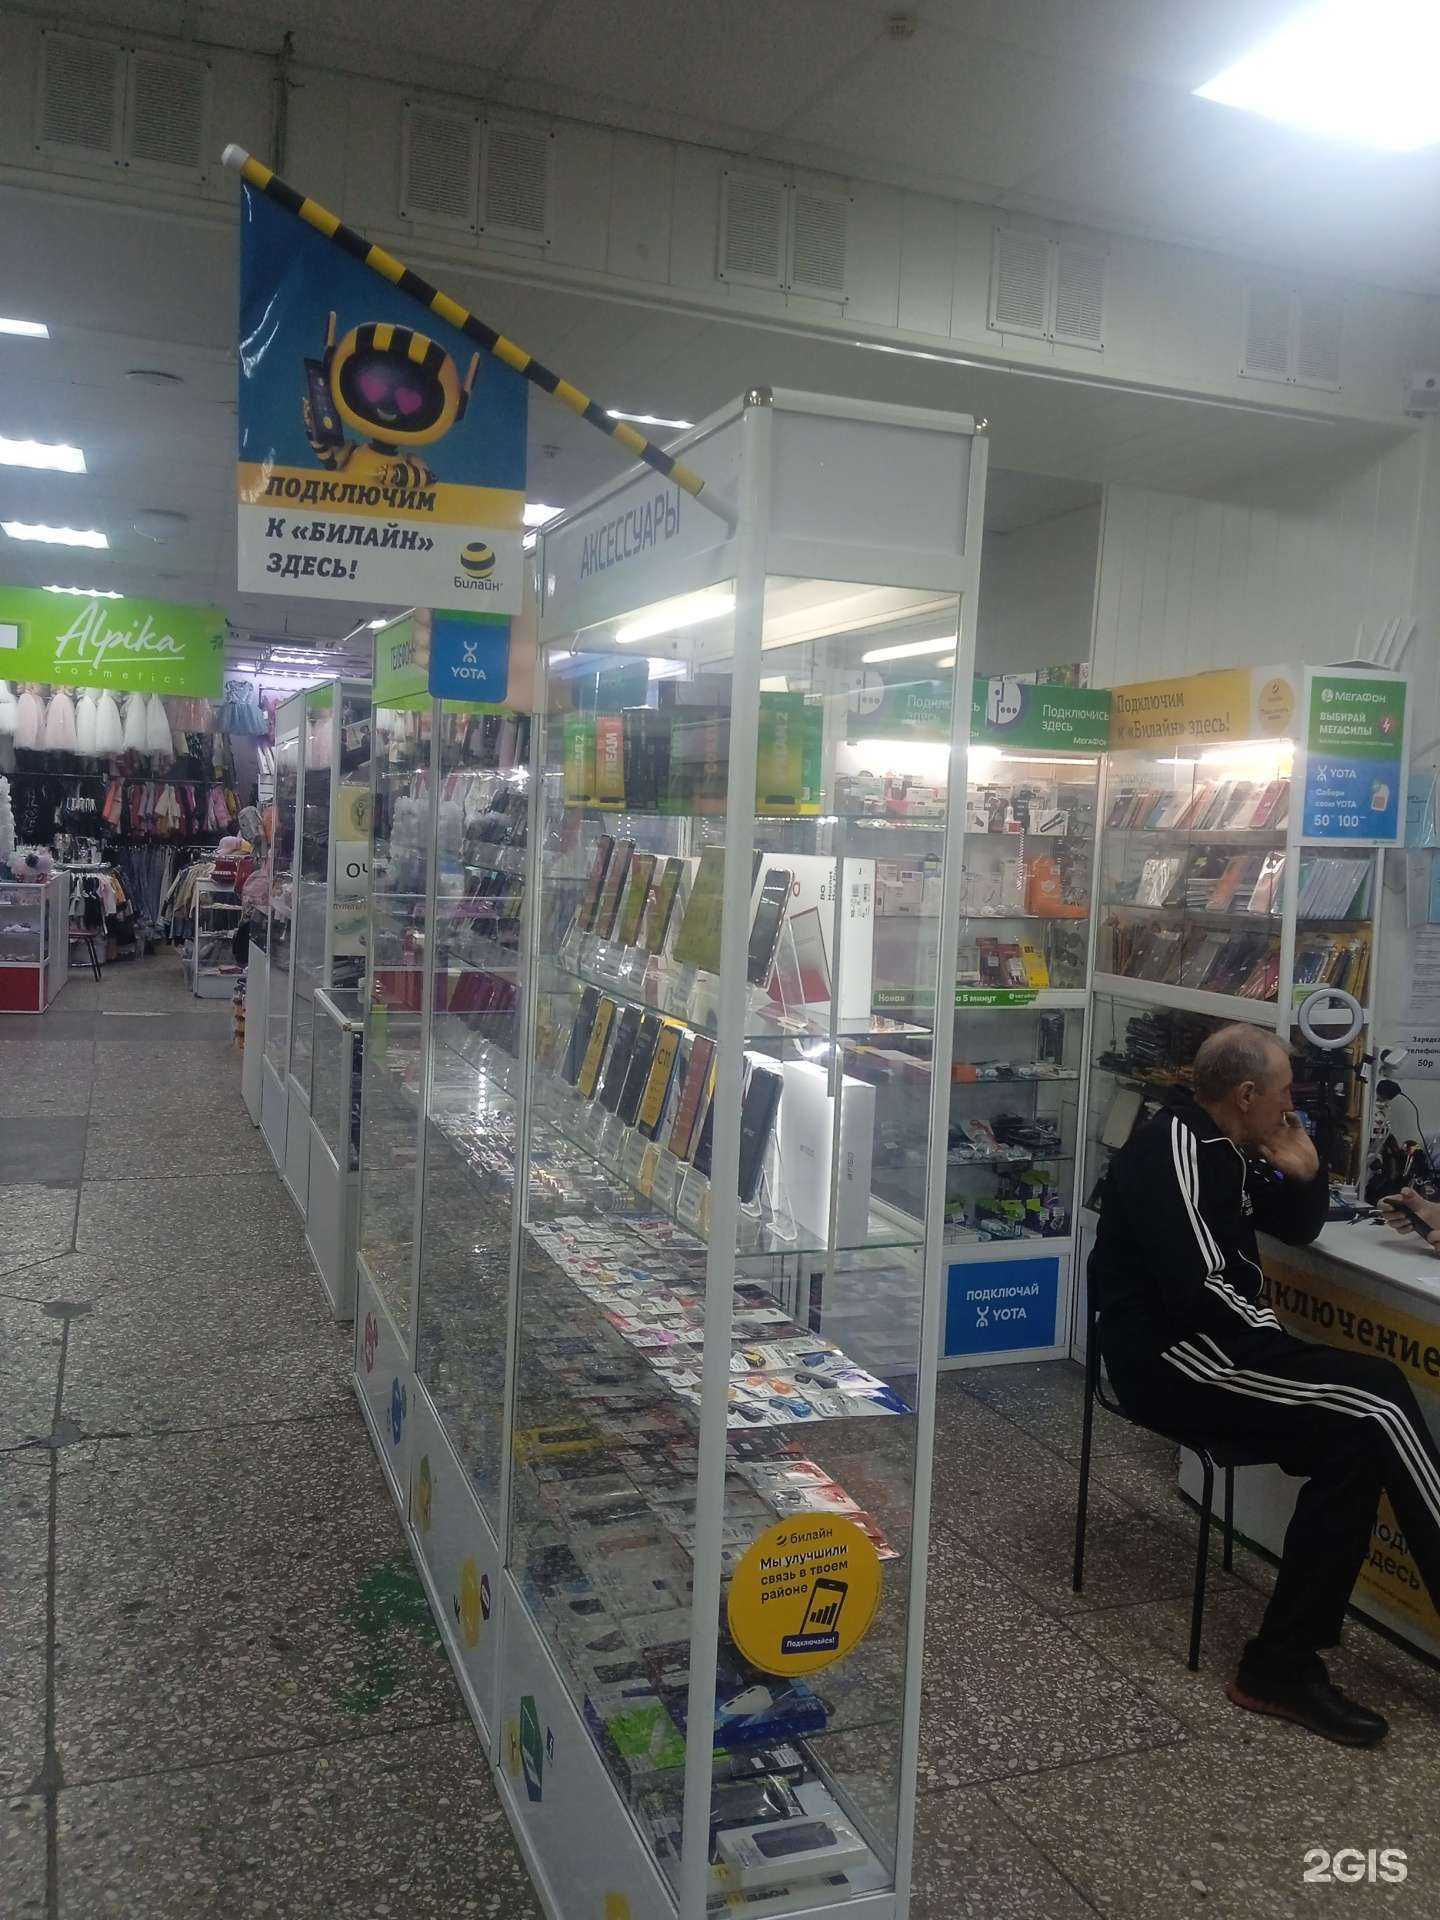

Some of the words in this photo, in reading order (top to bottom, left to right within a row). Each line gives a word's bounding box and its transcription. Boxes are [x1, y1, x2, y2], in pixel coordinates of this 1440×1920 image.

[265, 475, 437, 512] ПОДКЛЮЧИМ
[265, 517, 286, 538] К
[291, 521, 435, 552] «БИЛАЙН»
[580, 485, 681, 579] АКСЕССУАРЫ
[266, 552, 358, 580] ЗДЕСЬ!
[453, 576, 501, 592] Билайн
[55, 600, 186, 669] Alpika
[55, 665, 185, 684] cosmetics
[451, 666, 488, 680] YOTA
[1117, 692, 1185, 714] Подключим
[1042, 704, 1109, 722] Подключись
[1319, 711, 1366, 723] ВЫБИРАЙ
[1041, 719, 1073, 732] здесь
[1189, 712, 1231, 737] здесь!
[1319, 725, 1373, 736] МЕГАСИЛЫ
[1330, 768, 1357, 779] YOTA
[1336, 800, 1357, 809] YOTA
[1314, 814, 1330, 827] 50
[1339, 815, 1360, 828] 100
[962, 994, 969, 1002] 5
[969, 995, 997, 1004] минут
[1417, 1058, 1434, 1068] 50р
[966, 1282, 1039, 1301] ПОДКЛЮЧАЙ
[993, 1307, 1027, 1320] YOTA
[790, 1528, 833, 1544] билайн
[760, 1557, 782, 1570] Мы
[785, 1544, 848, 1568] улучшили
[760, 1569, 796, 1585] связь
[799, 1569, 806, 1578] в
[810, 1559, 848, 1576] твоем
[761, 1583, 808, 1604] районе
